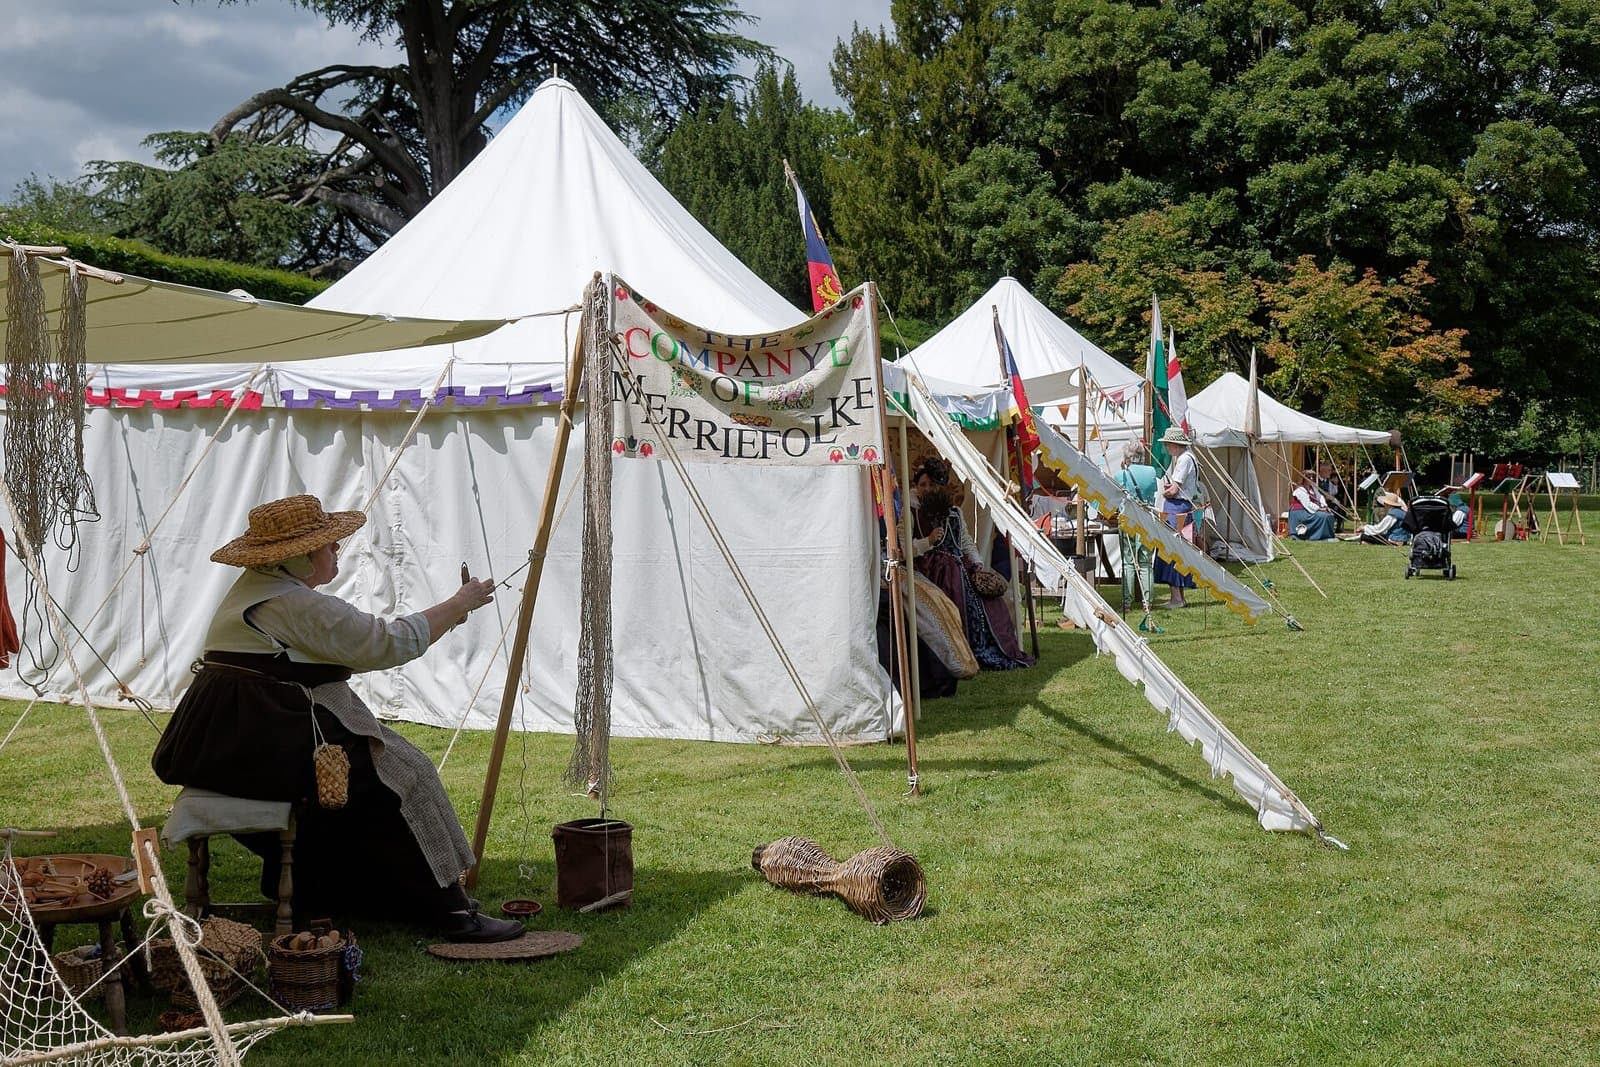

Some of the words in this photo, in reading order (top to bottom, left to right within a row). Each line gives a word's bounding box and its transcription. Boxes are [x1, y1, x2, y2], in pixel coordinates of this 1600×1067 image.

[625, 327, 853, 377] COMPANYE
[697, 328, 782, 351] THE
[711, 376, 763, 406] OF
